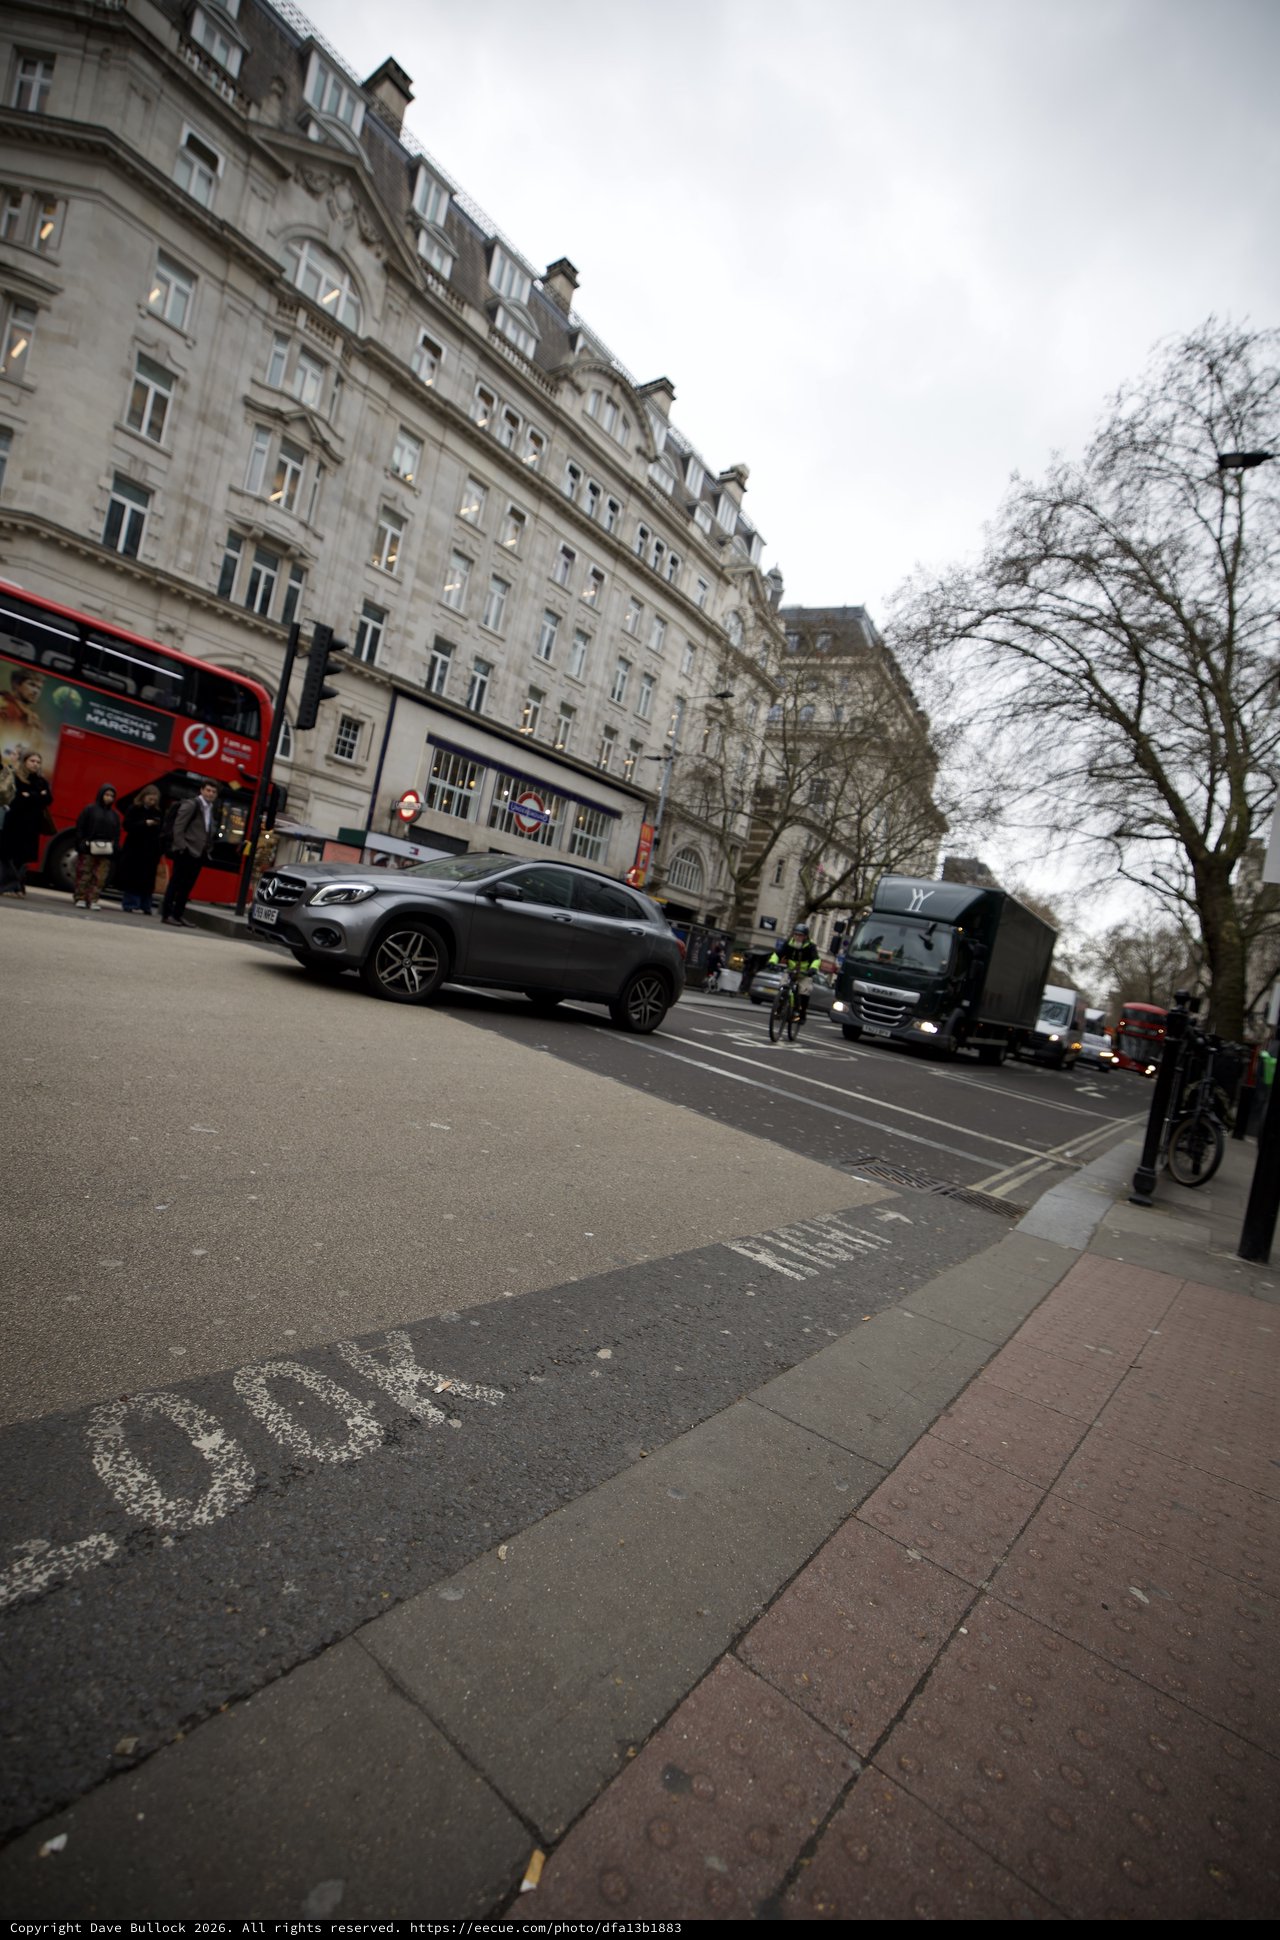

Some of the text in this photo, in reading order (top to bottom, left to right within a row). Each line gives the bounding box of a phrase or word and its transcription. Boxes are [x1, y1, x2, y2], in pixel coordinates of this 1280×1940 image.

[85, 713, 140, 737] MARCH
[141, 731, 157, 744] 19
[92, 708, 105, 719] IN
[107, 711, 153, 733] CINEMAS
[511, 802, 549, 822] UNDERGROUND
[264, 908, 277, 922] NRE
[719, 1213, 893, 1281] RIGHT
